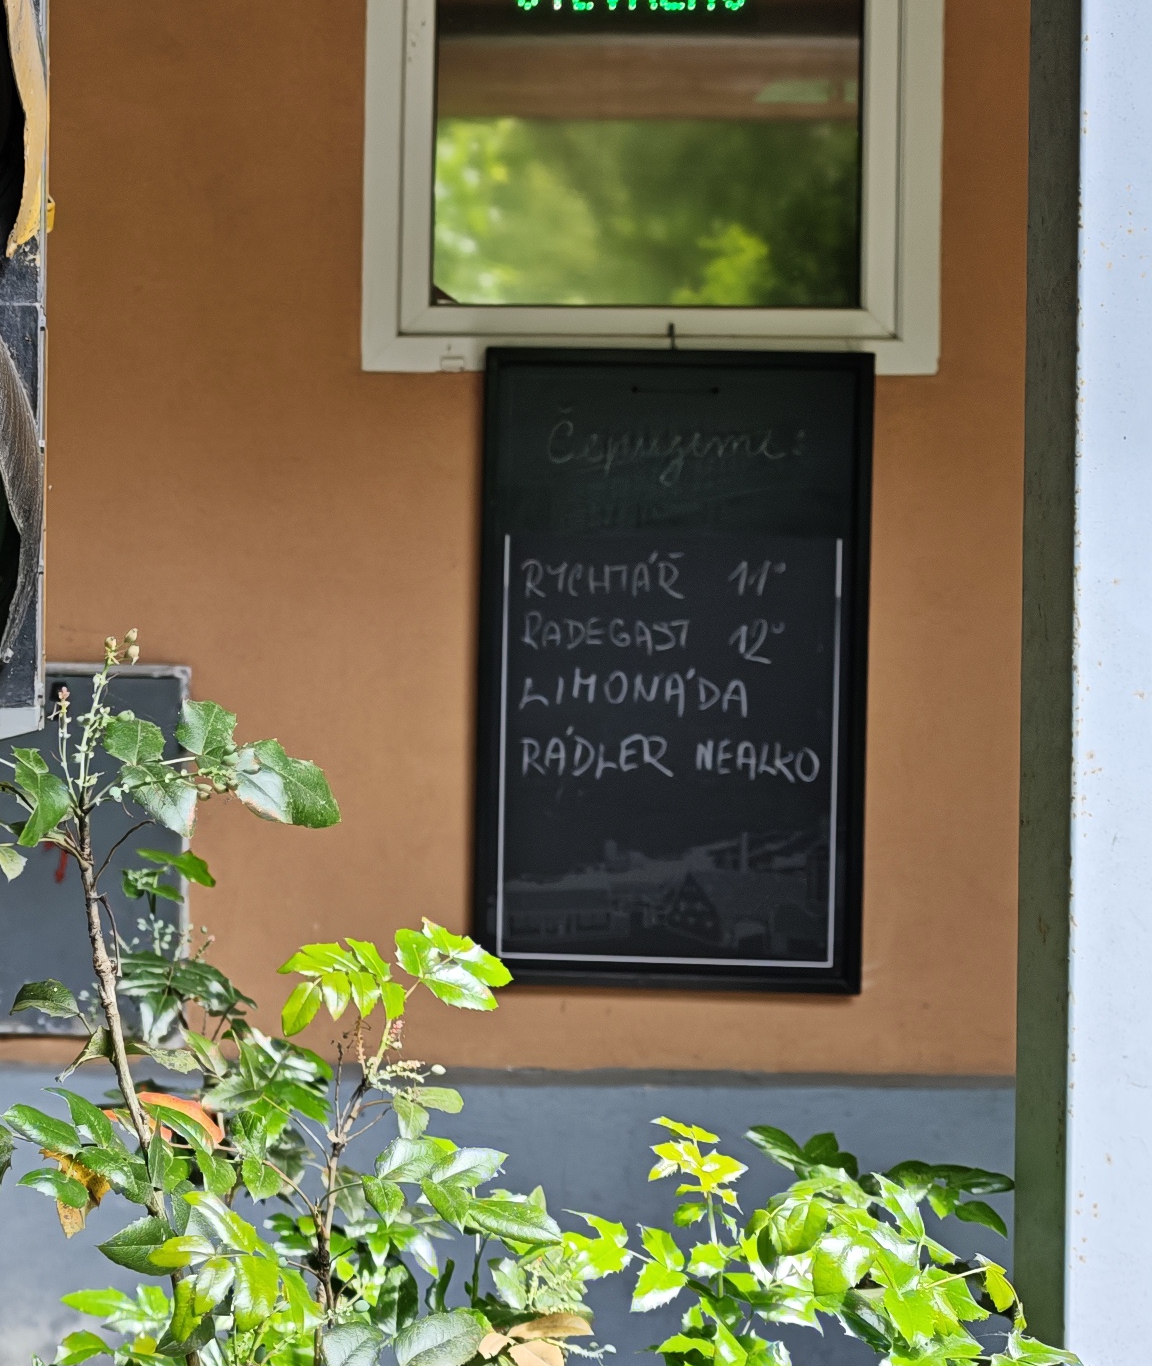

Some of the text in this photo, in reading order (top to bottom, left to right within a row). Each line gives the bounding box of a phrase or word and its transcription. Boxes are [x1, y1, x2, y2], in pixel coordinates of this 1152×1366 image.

[521, 550, 685, 600] RYCHTÁŘ
[522, 610, 691, 656] RADEGAST
[518, 666, 748, 718] LIMONÁDA
[521, 725, 821, 784] RÁDLER NEALKO
